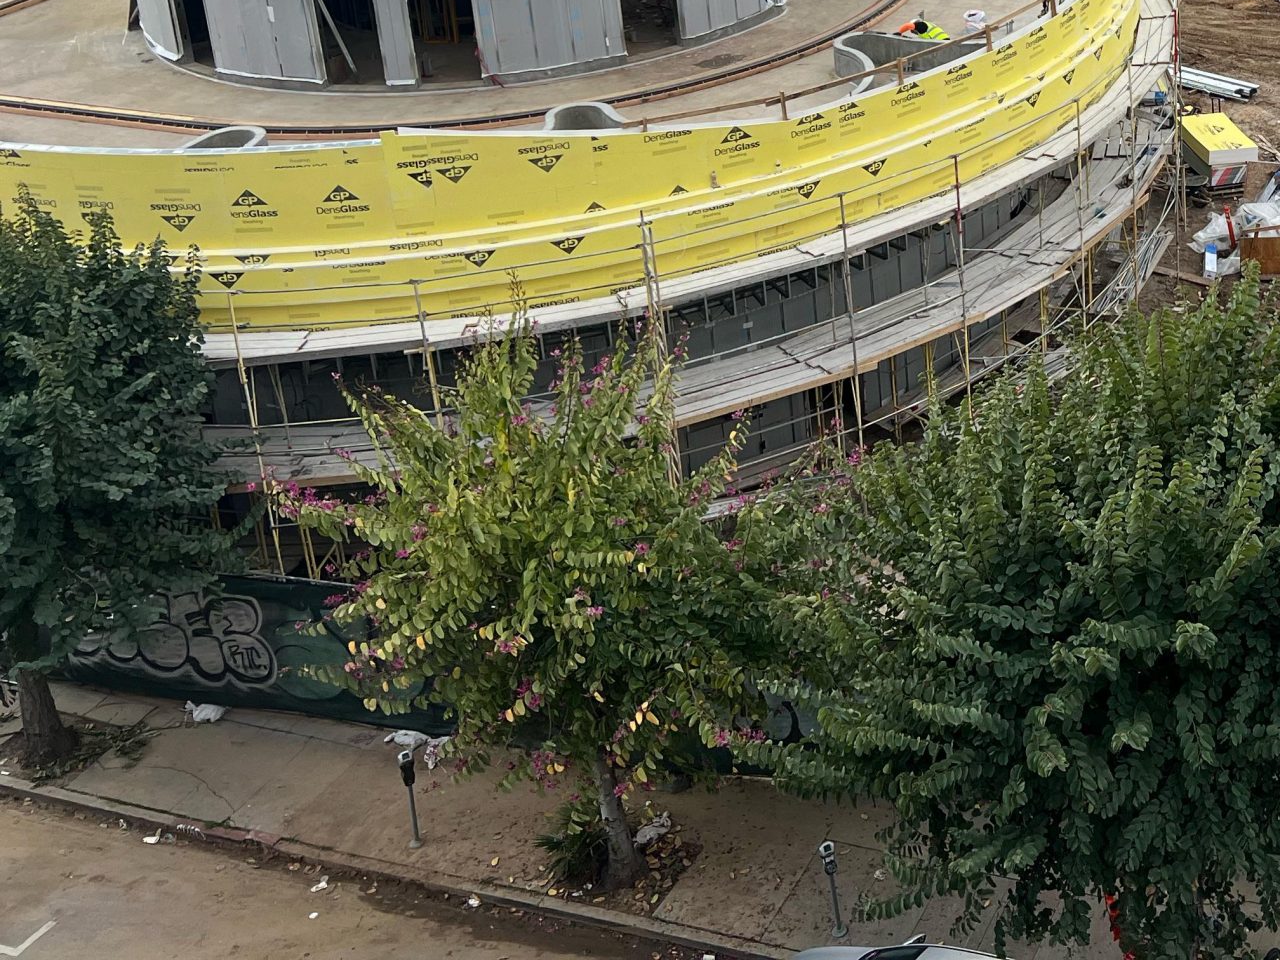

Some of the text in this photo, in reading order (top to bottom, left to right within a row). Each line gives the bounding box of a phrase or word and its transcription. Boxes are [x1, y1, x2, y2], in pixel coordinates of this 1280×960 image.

[891, 90, 926, 107] DensGlass
[791, 121, 832, 139] DensGlass
[643, 129, 693, 144] DensGlass
[727, 132, 745, 141] GP
[518, 142, 571, 154] DensGlass
[714, 141, 761, 157] DensGlass
[537, 156, 558, 167] GP
[868, 161, 883, 173] GP
[446, 167, 465, 177] GP
[800, 184, 815, 194] GP
[238, 196, 258, 205] GP
[329, 192, 350, 201] GP
[150, 204, 202, 212] DensGlass
[316, 204, 370, 215] DensGlass
[170, 216, 189, 225] GP
[389, 239, 443, 251] DensGlass
[560, 238, 580, 249] GP
[470, 251, 489, 262] GP
[218, 273, 238, 282] GP
